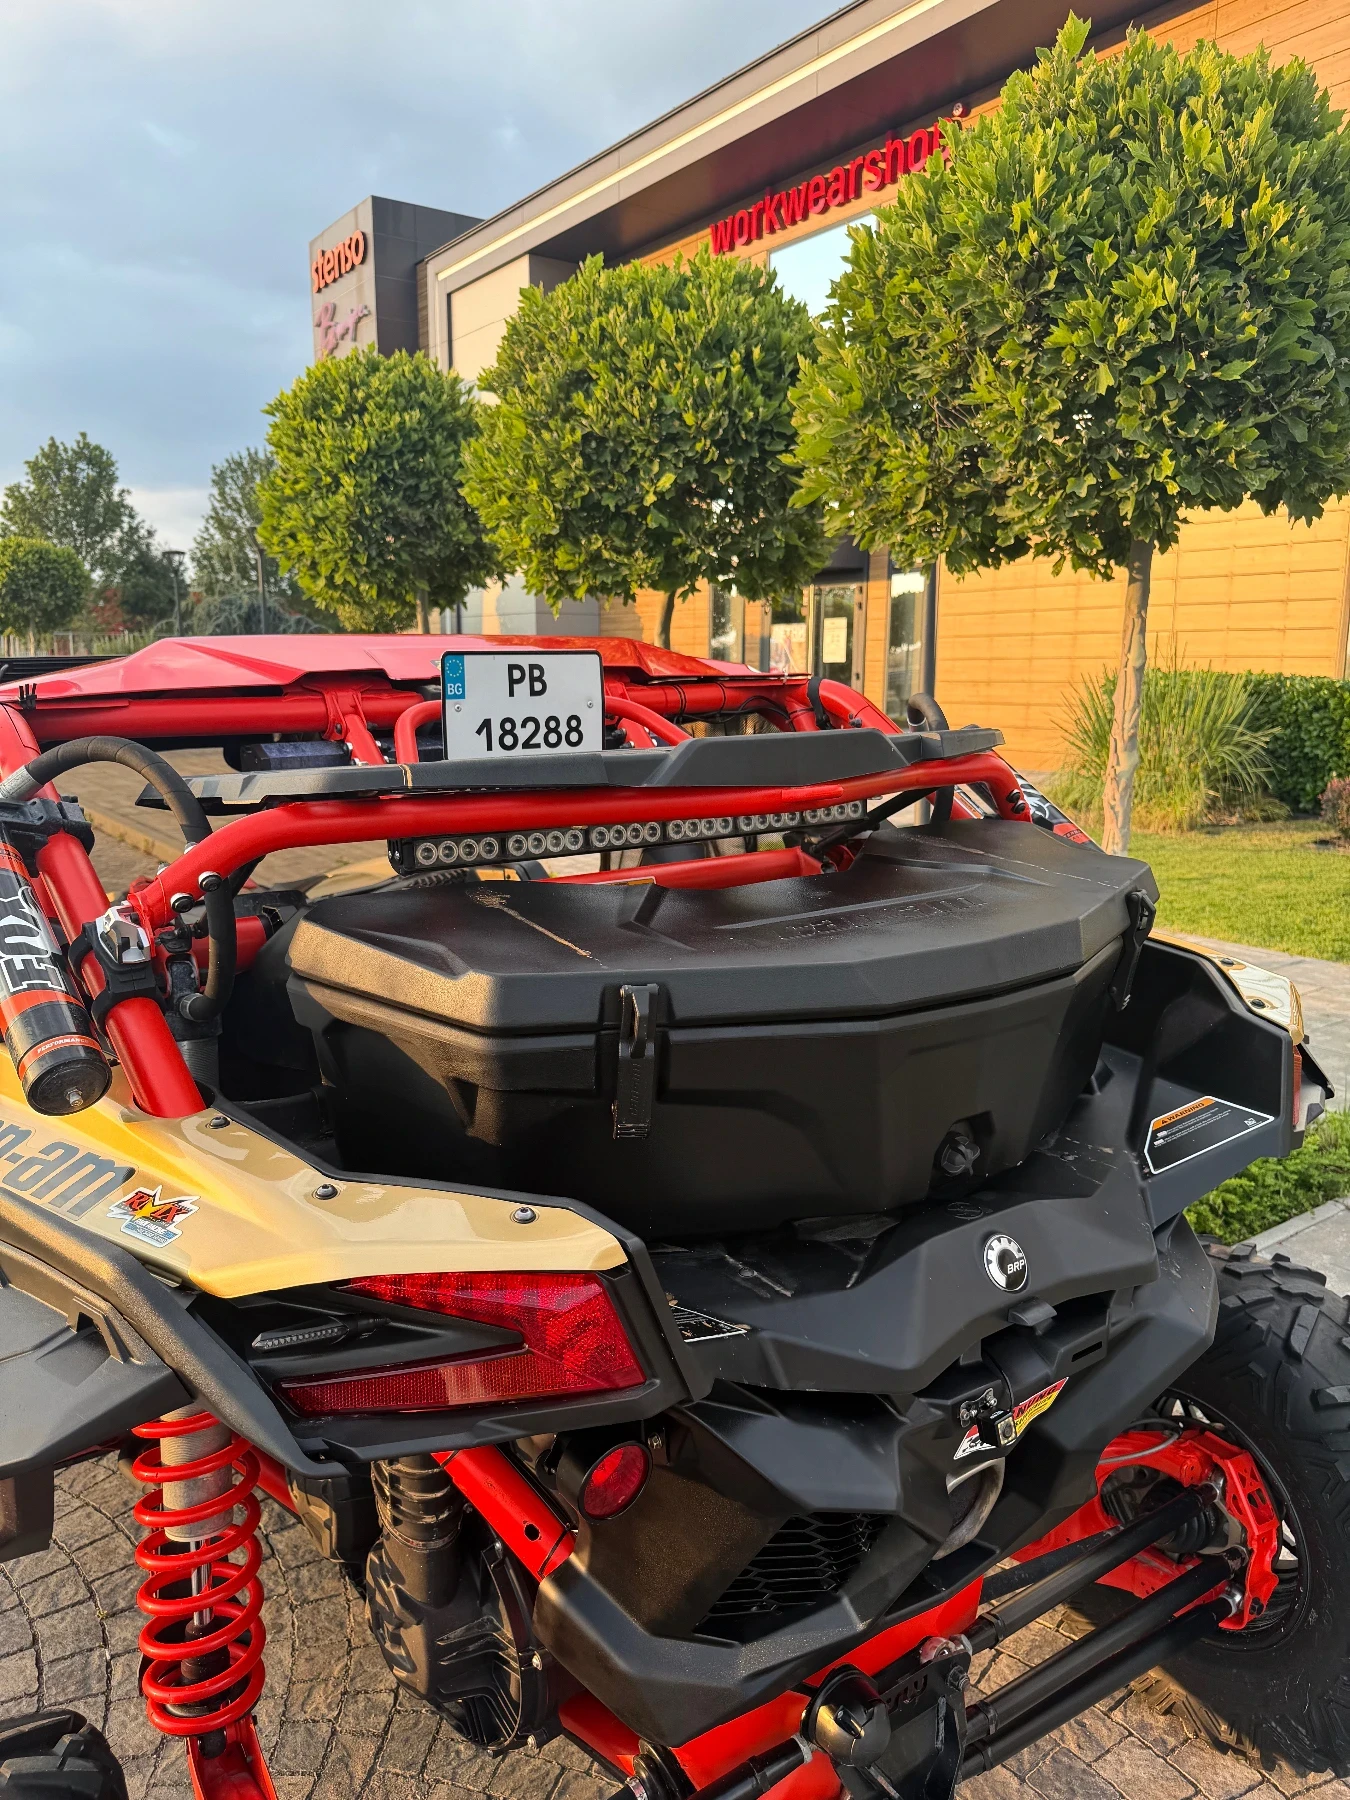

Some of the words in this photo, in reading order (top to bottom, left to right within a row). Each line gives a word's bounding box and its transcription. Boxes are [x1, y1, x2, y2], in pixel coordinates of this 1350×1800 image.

[311, 229, 366, 294] stenso
[447, 683, 463, 696] BG
[507, 663, 548, 698] PB
[475, 714, 584, 752] 18288
[1166, 1102, 1206, 1122] WARNING
[1007, 1259, 1025, 1275] BRP
